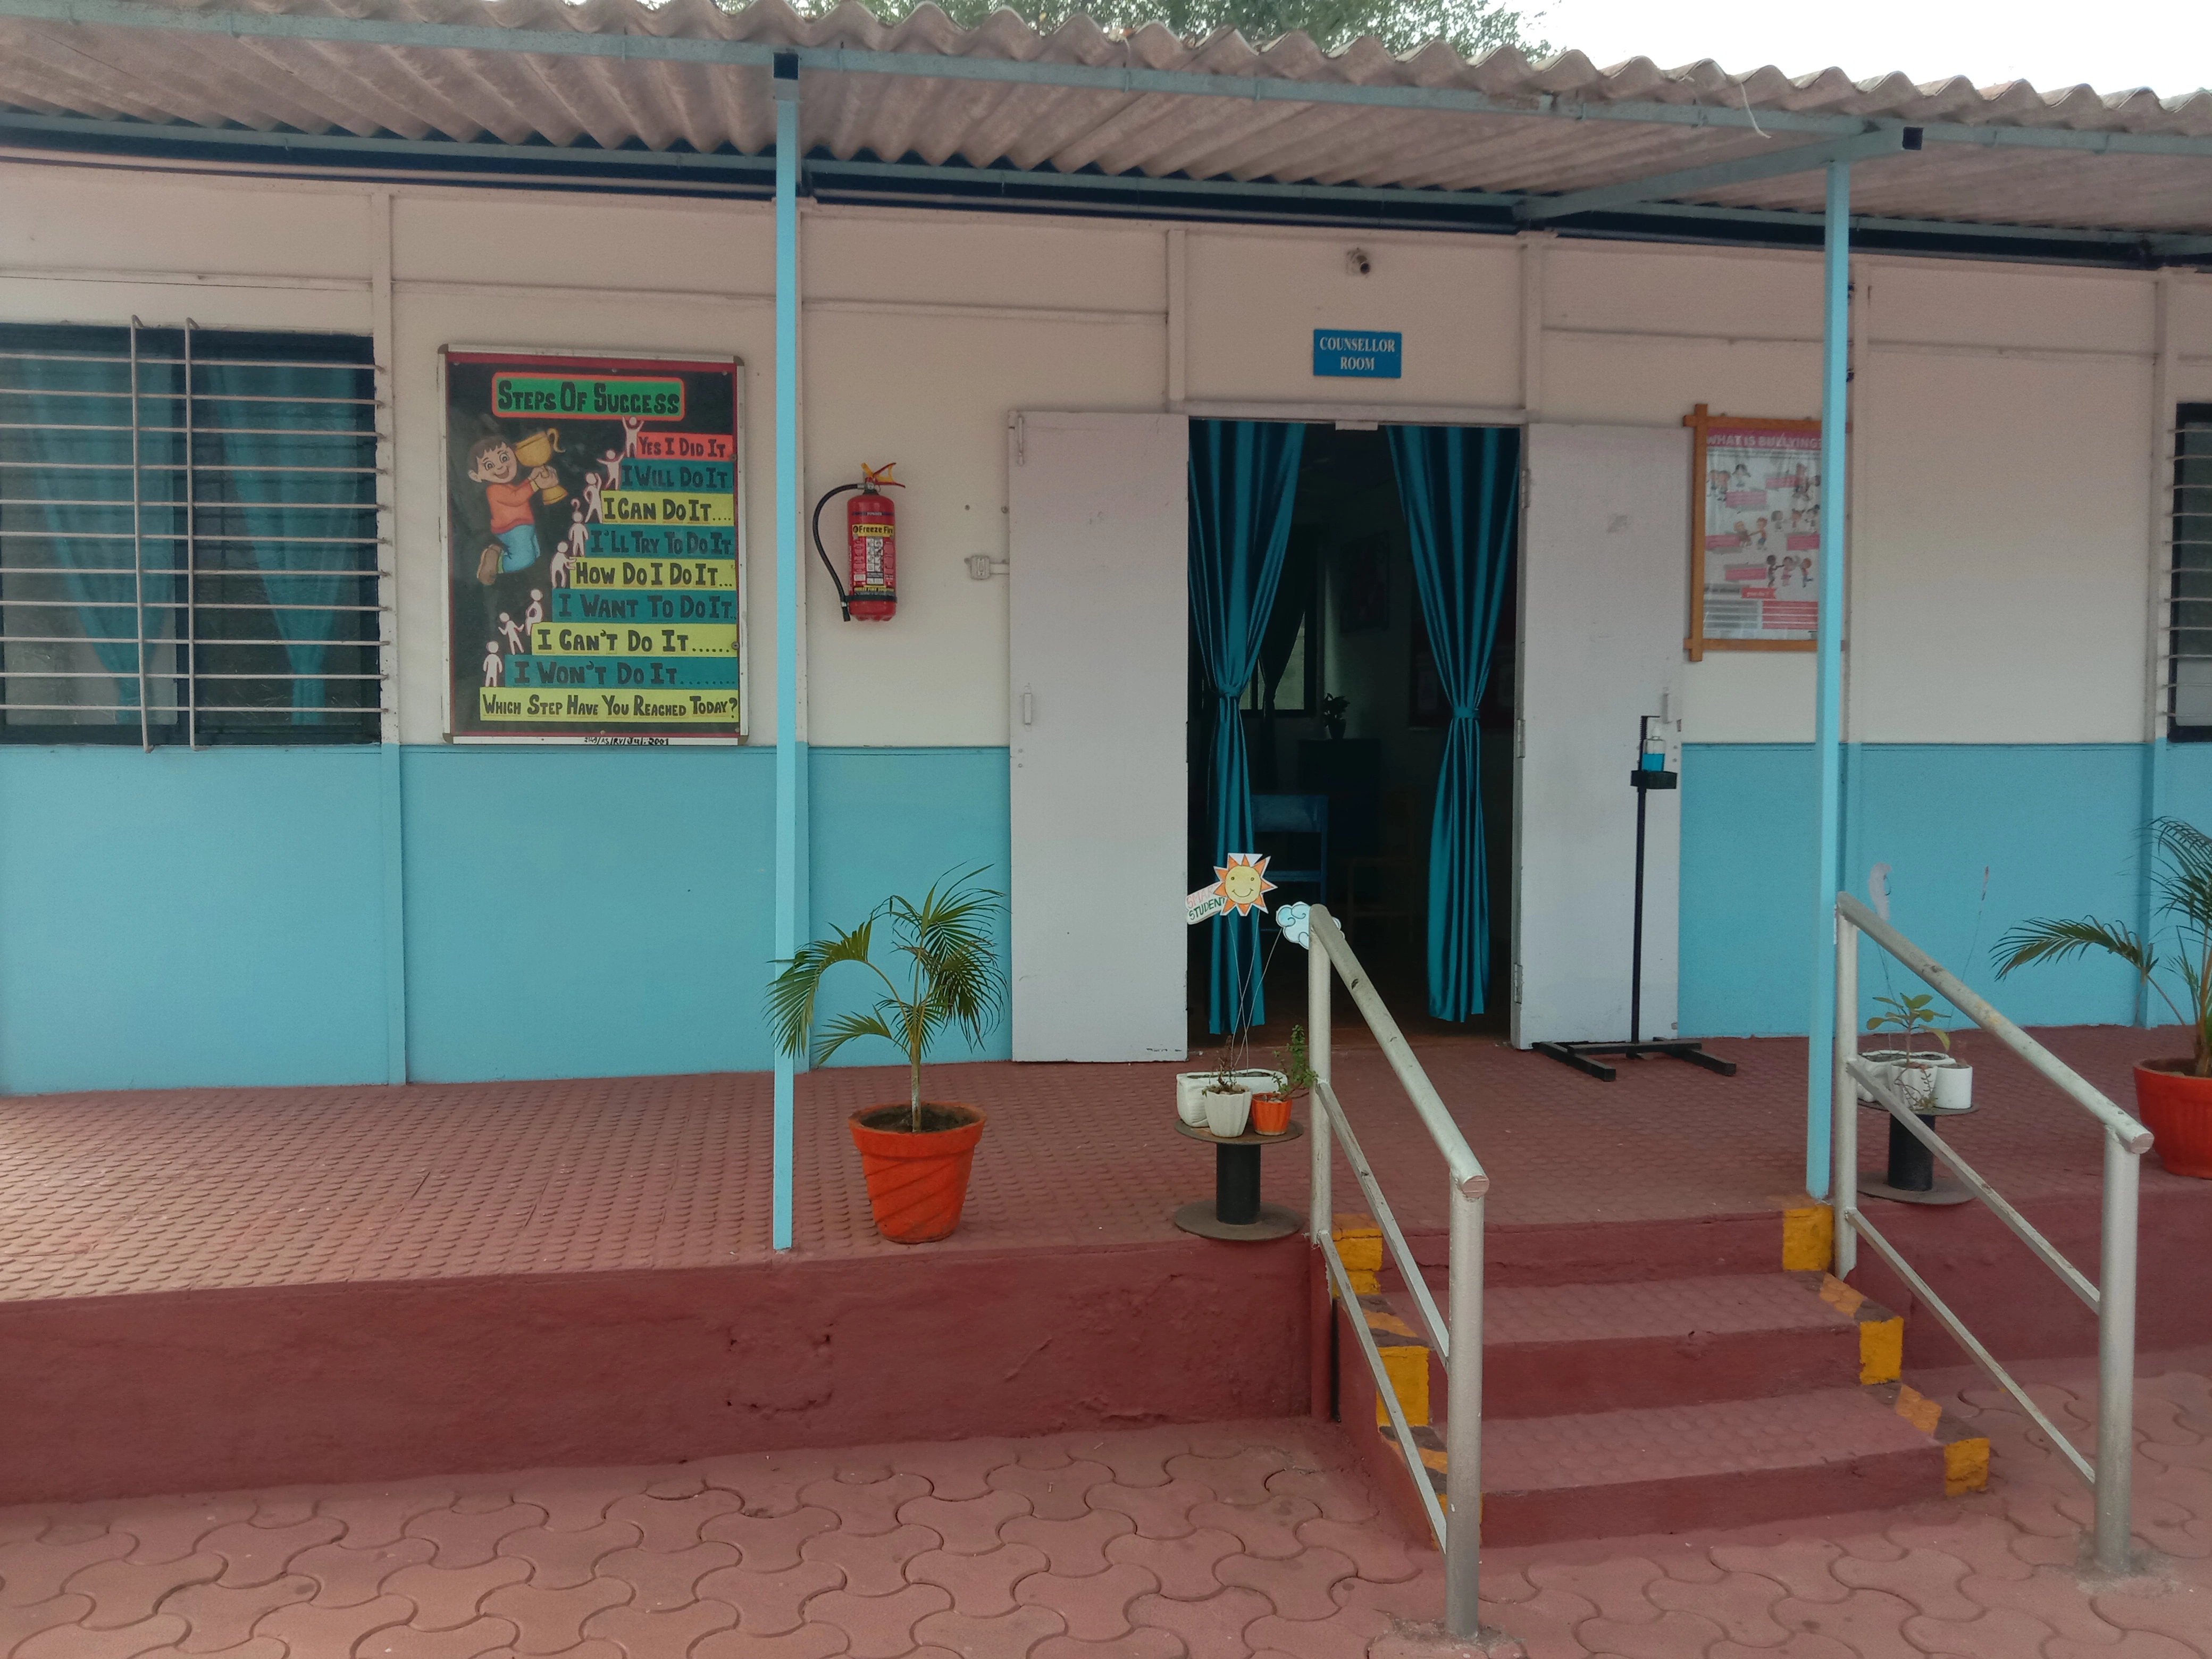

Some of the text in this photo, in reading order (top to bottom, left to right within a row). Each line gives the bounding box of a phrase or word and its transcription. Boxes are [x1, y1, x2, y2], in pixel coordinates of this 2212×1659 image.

[1319, 337, 1395, 352] COUNSELLOR
[1340, 356, 1375, 371] ROOM
[498, 380, 680, 414] STEPS OF SUCCESS
[639, 437, 661, 456] YES
[665, 438, 675, 455] I
[679, 438, 704, 456] DID
[1707, 434, 1742, 446] WHAT
[1744, 435, 1755, 447] IS
[622, 465, 633, 487] I
[635, 466, 674, 487] WILL
[680, 466, 703, 488] DO
[604, 498, 615, 520] I
[618, 498, 656, 520] CAN
[663, 499, 686, 521] DO
[631, 531, 660, 554] TRY
[665, 532, 683, 555] TO
[687, 532, 708, 554] DO
[576, 562, 615, 584] HOW
[623, 562, 647, 585] DO
[650, 563, 663, 585] I
[670, 563, 692, 585] DO
[558, 593, 572, 617] I
[580, 594, 638, 618] WANT
[647, 595, 674, 618] TO
[680, 595, 706, 618] DO
[538, 629, 552, 650] I
[559, 629, 618, 651] CAN'T
[628, 630, 653, 651] DO
[514, 661, 530, 684] I
[537, 660, 606, 685] WON'T
[617, 663, 644, 684] DO
[482, 694, 738, 718] WHICH STEP HAVE YOU REACHED TODAY?
[1189, 897, 1225, 920] STUDENT
